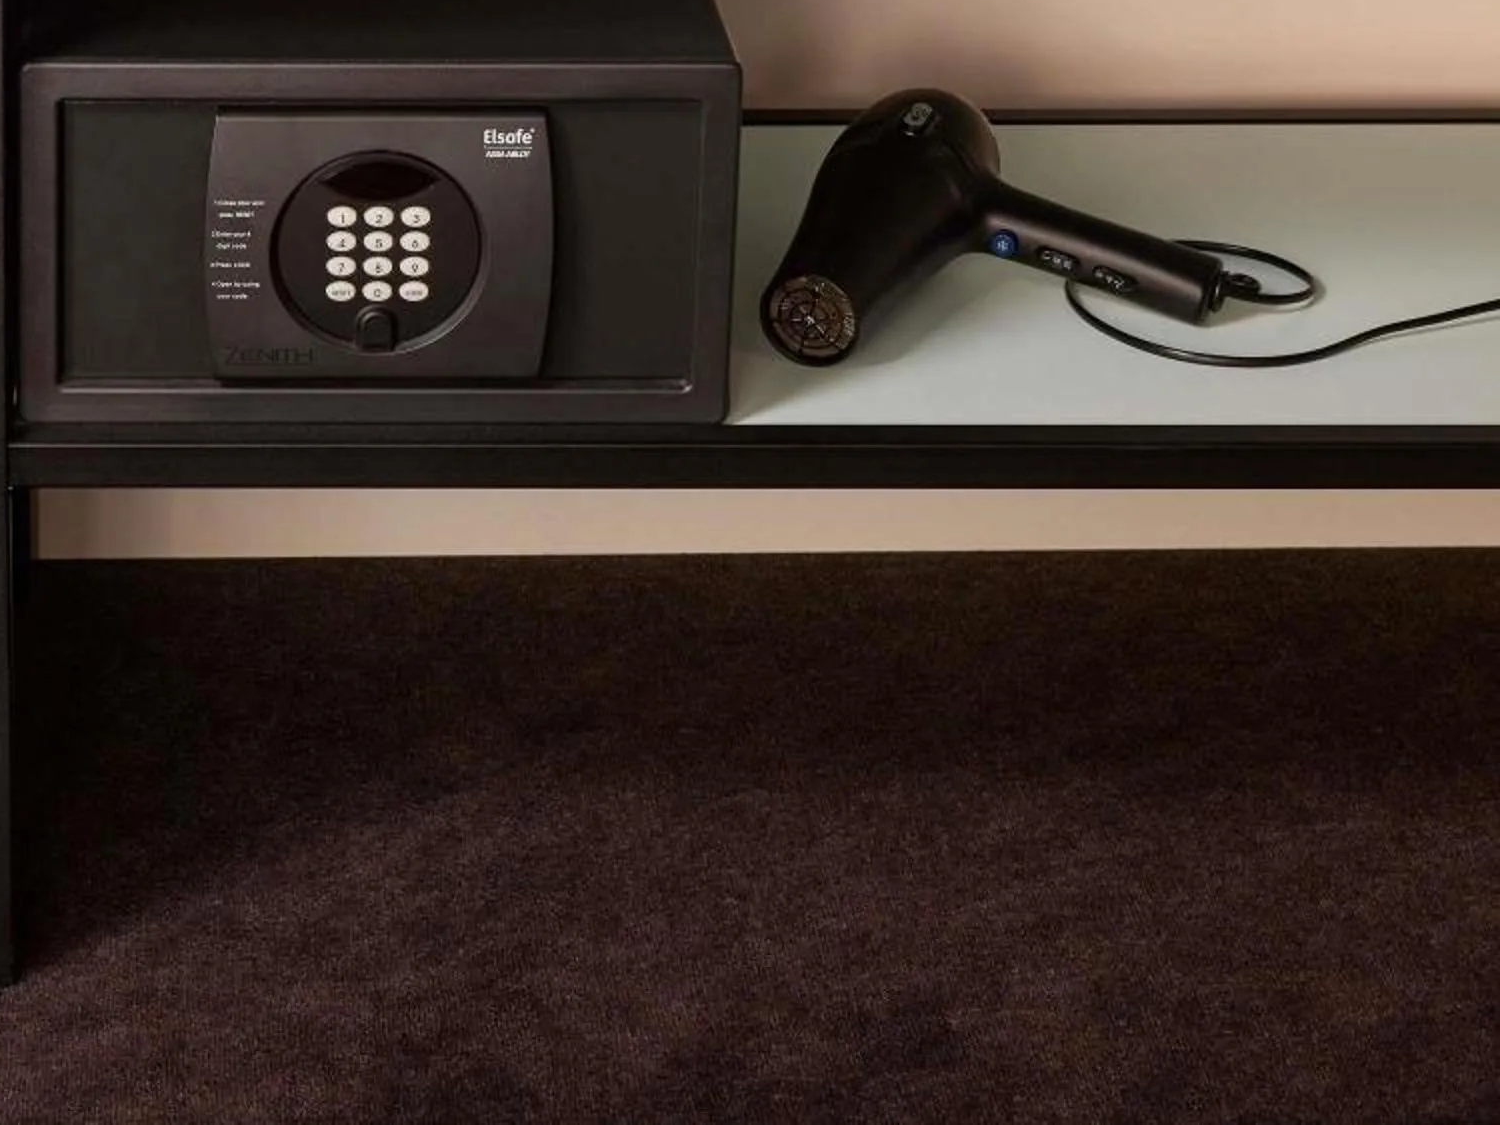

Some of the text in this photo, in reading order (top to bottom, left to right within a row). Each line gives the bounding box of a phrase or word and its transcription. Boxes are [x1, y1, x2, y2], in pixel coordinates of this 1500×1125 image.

[375, 213, 384, 224] 2
[413, 213, 421, 224] 3
[338, 238, 419, 249] 4 5 6
[338, 262, 419, 274] 7 8 9
[373, 288, 381, 298] 0
